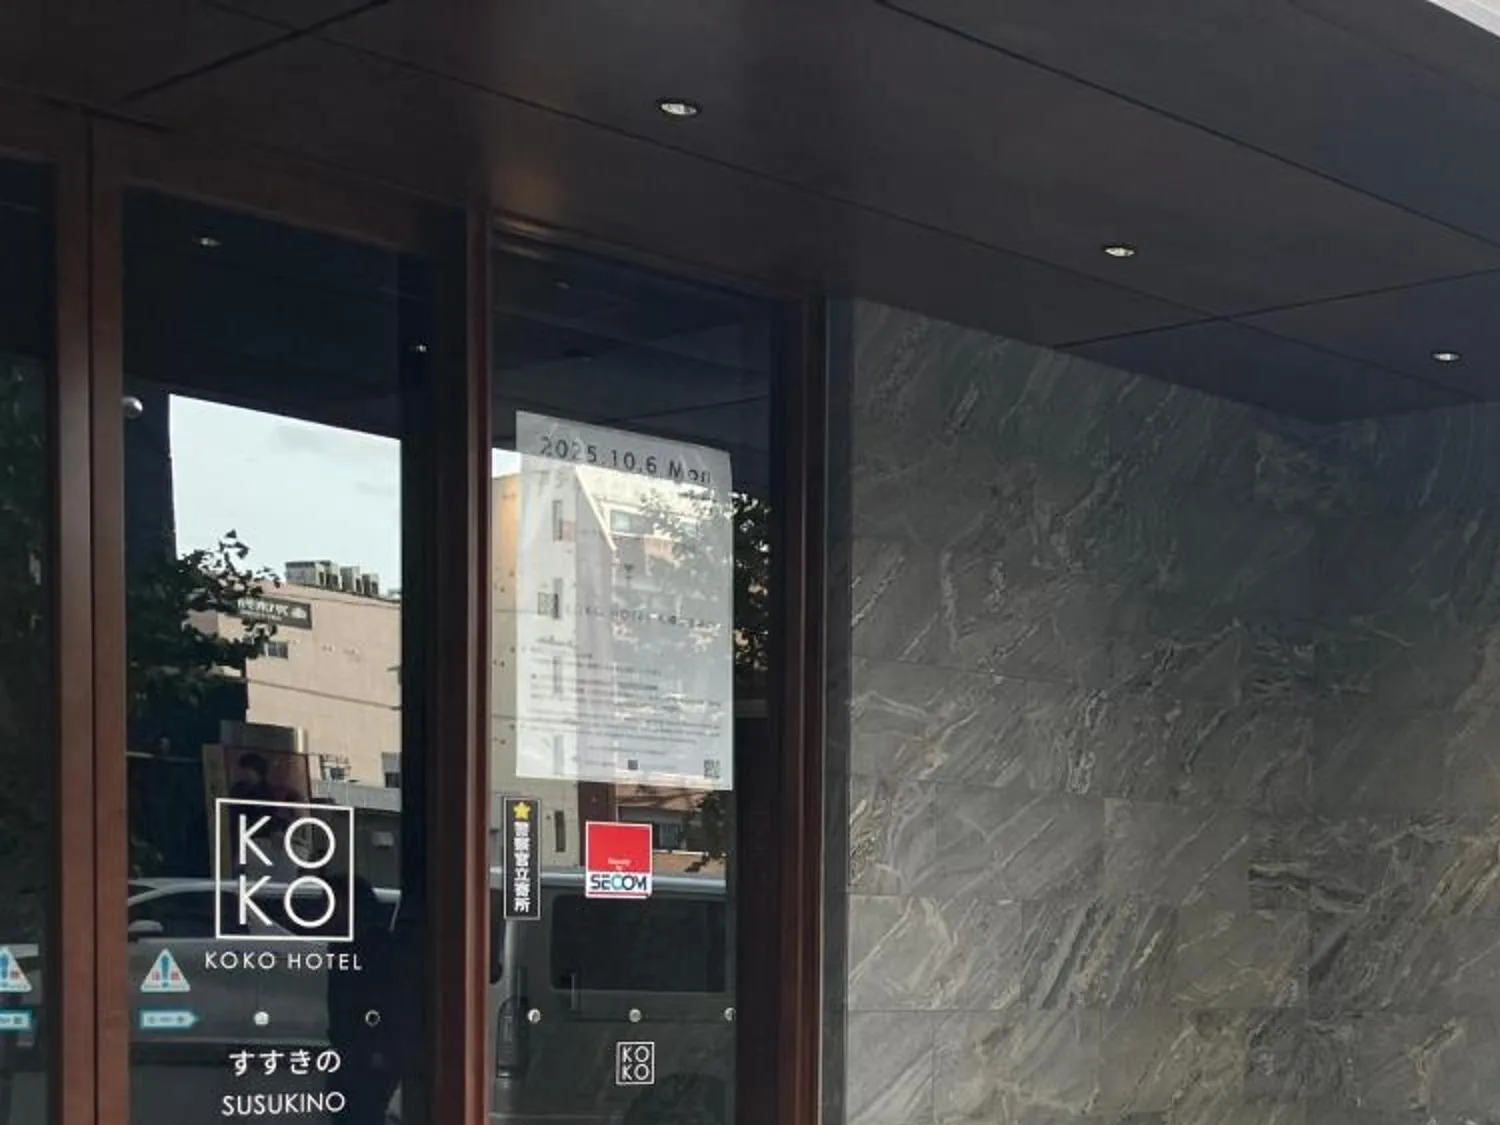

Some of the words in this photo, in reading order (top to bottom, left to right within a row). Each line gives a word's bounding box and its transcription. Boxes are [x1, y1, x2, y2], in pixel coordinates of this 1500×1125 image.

[539, 436, 658, 474] 2025.10.6
[239, 813, 336, 869] KO
[590, 874, 647, 891] SECOM
[239, 874, 336, 929] KO
[204, 951, 276, 970] KOKO
[287, 952, 363, 971] HOTEL
[228, 1049, 342, 1078] すすきの
[622, 1045, 650, 1063] KO
[622, 1063, 650, 1081] KO
[221, 1091, 346, 1117] SUSUKINO
